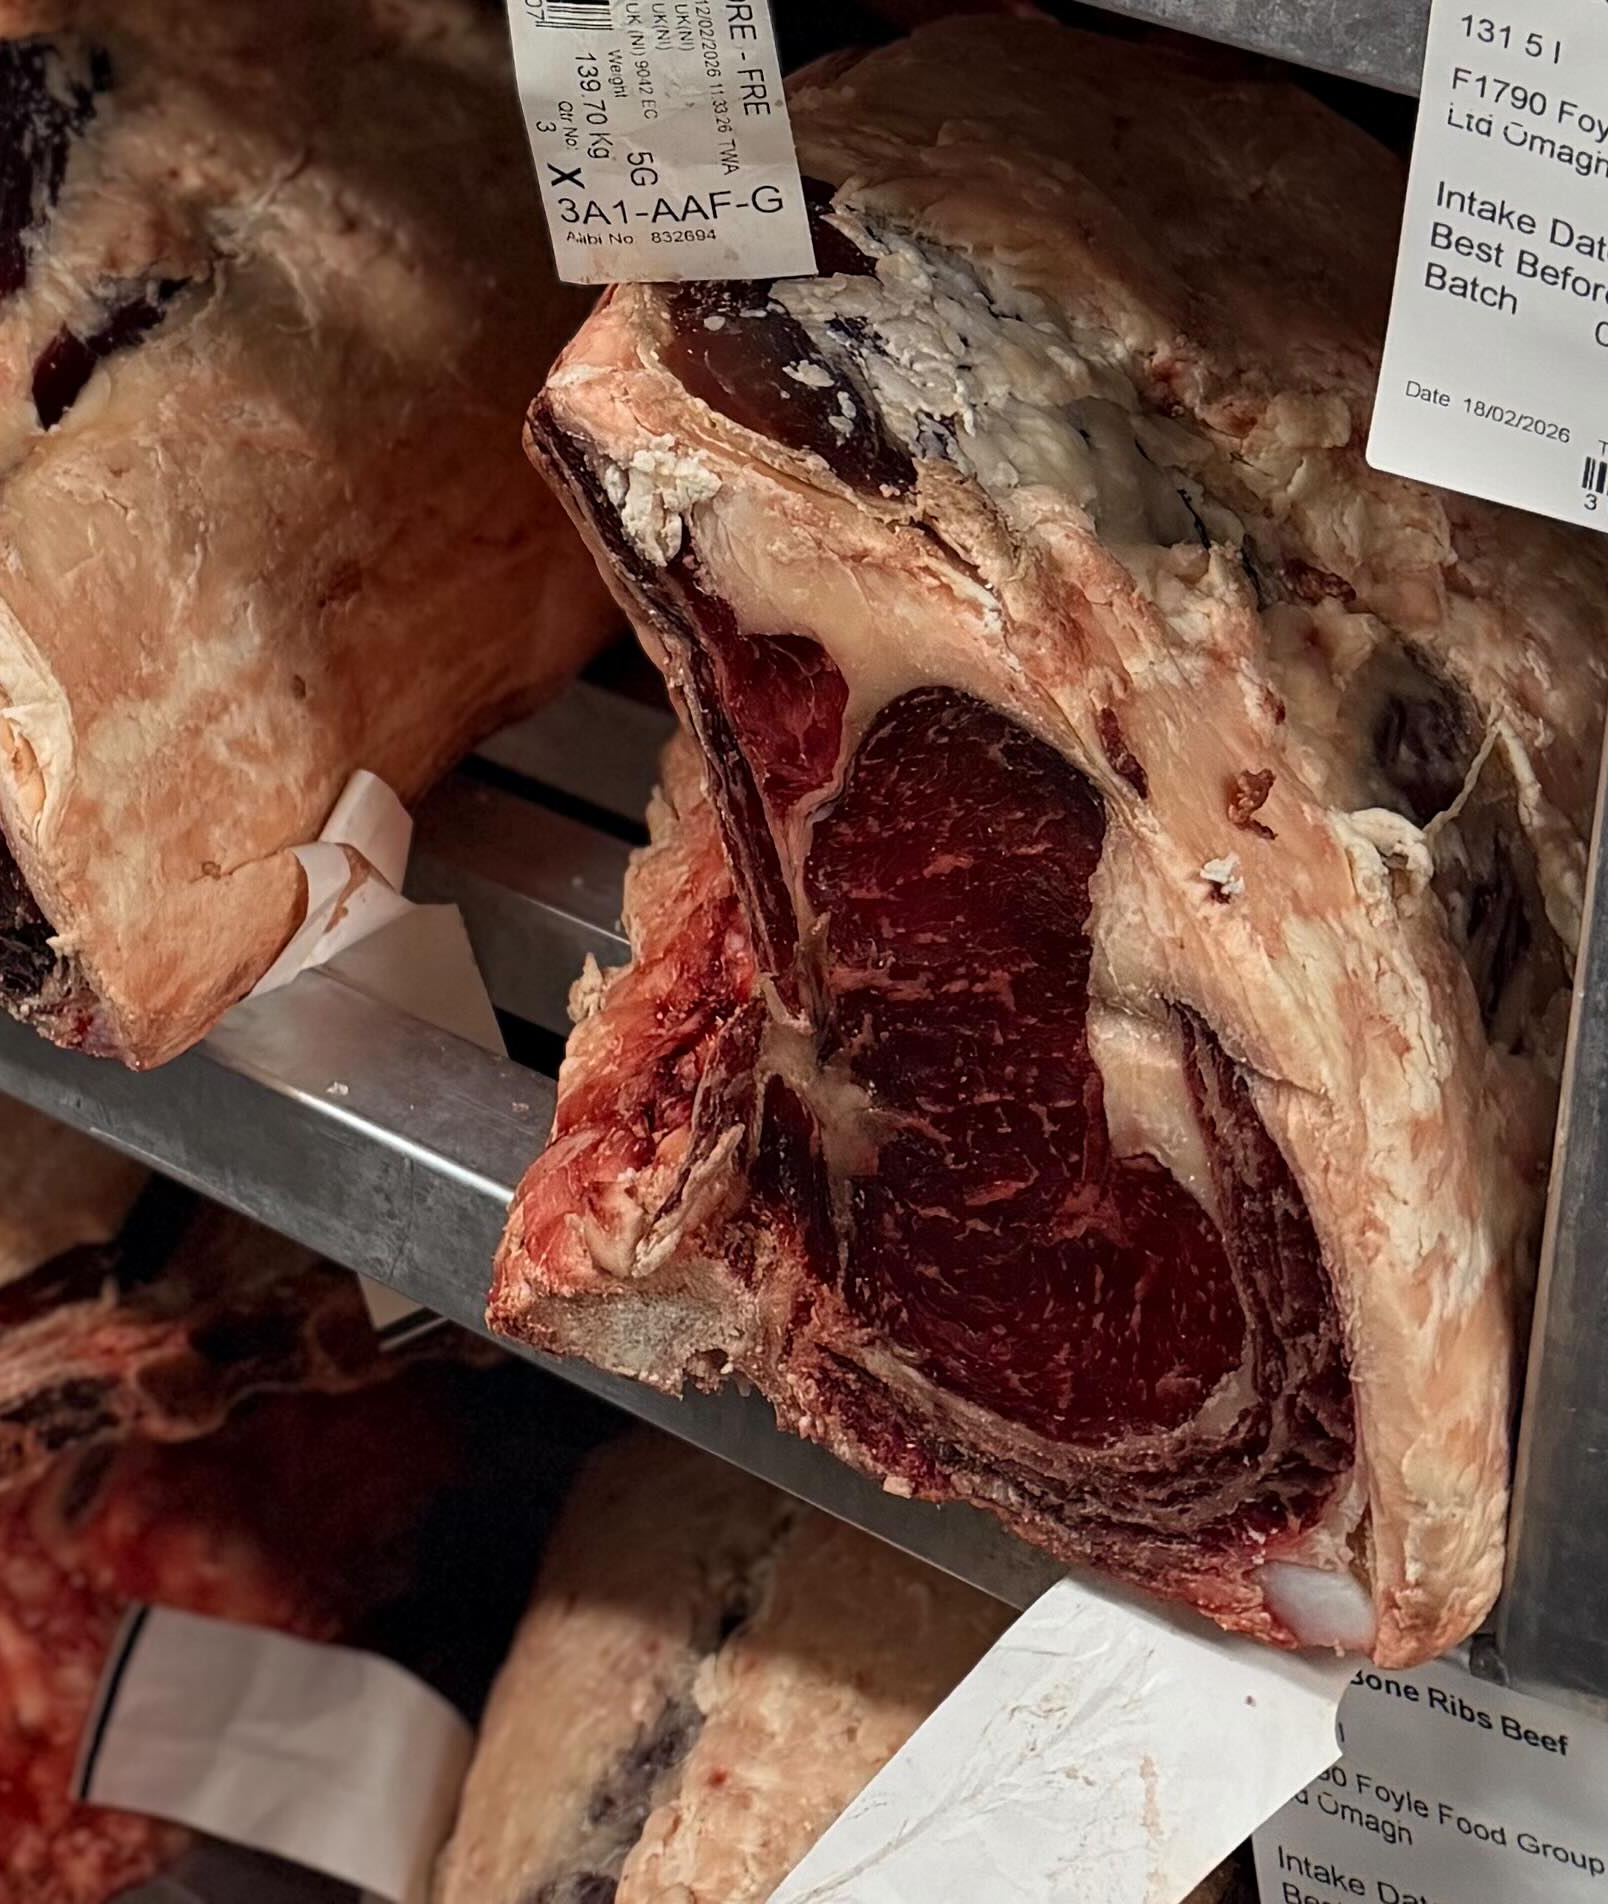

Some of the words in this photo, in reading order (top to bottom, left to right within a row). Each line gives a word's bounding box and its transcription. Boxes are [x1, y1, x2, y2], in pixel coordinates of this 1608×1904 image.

[626, 3, 642, 25] UK
[652, 3, 672, 50] UK(NI)
[675, 4, 694, 51] UK(NI)
[1461, 14, 1511, 49] 131
[1525, 33, 1543, 57] 5
[576, 53, 606, 124] 139.70
[608, 50, 628, 97] Weight
[635, 61, 653, 94] 9042
[696, 0, 721, 77] 12/02/2026
[720, 139, 739, 175] TWA
[737, 69, 771, 115] FRE
[1451, 67, 1547, 116] F1790
[536, 121, 556, 132] 3
[642, 100, 658, 119] EC
[587, 133, 613, 158] Kg
[627, 152, 657, 186] 5G
[547, 163, 585, 188] X
[557, 185, 784, 225] 3A1-AAF-G
[1437, 182, 1536, 234] Intake
[1549, 217, 1608, 262] Dat
[608, 232, 634, 245] No
[1430, 221, 1504, 267] Best
[1516, 249, 1608, 304] Befor
[1424, 261, 1518, 315] Batch
[1405, 380, 1451, 407] Date
[1464, 397, 1570, 444] 18/02/2026
[1583, 494, 1598, 511] 3
[1428, 1687, 1493, 1730] Ribs
[1501, 1714, 1569, 1756] Beef
[1356, 1773, 1429, 1818] Foyle
[1438, 1803, 1507, 1847] Food
[1517, 1833, 1605, 1877] Group
[1278, 1845, 1365, 1896] Intake
